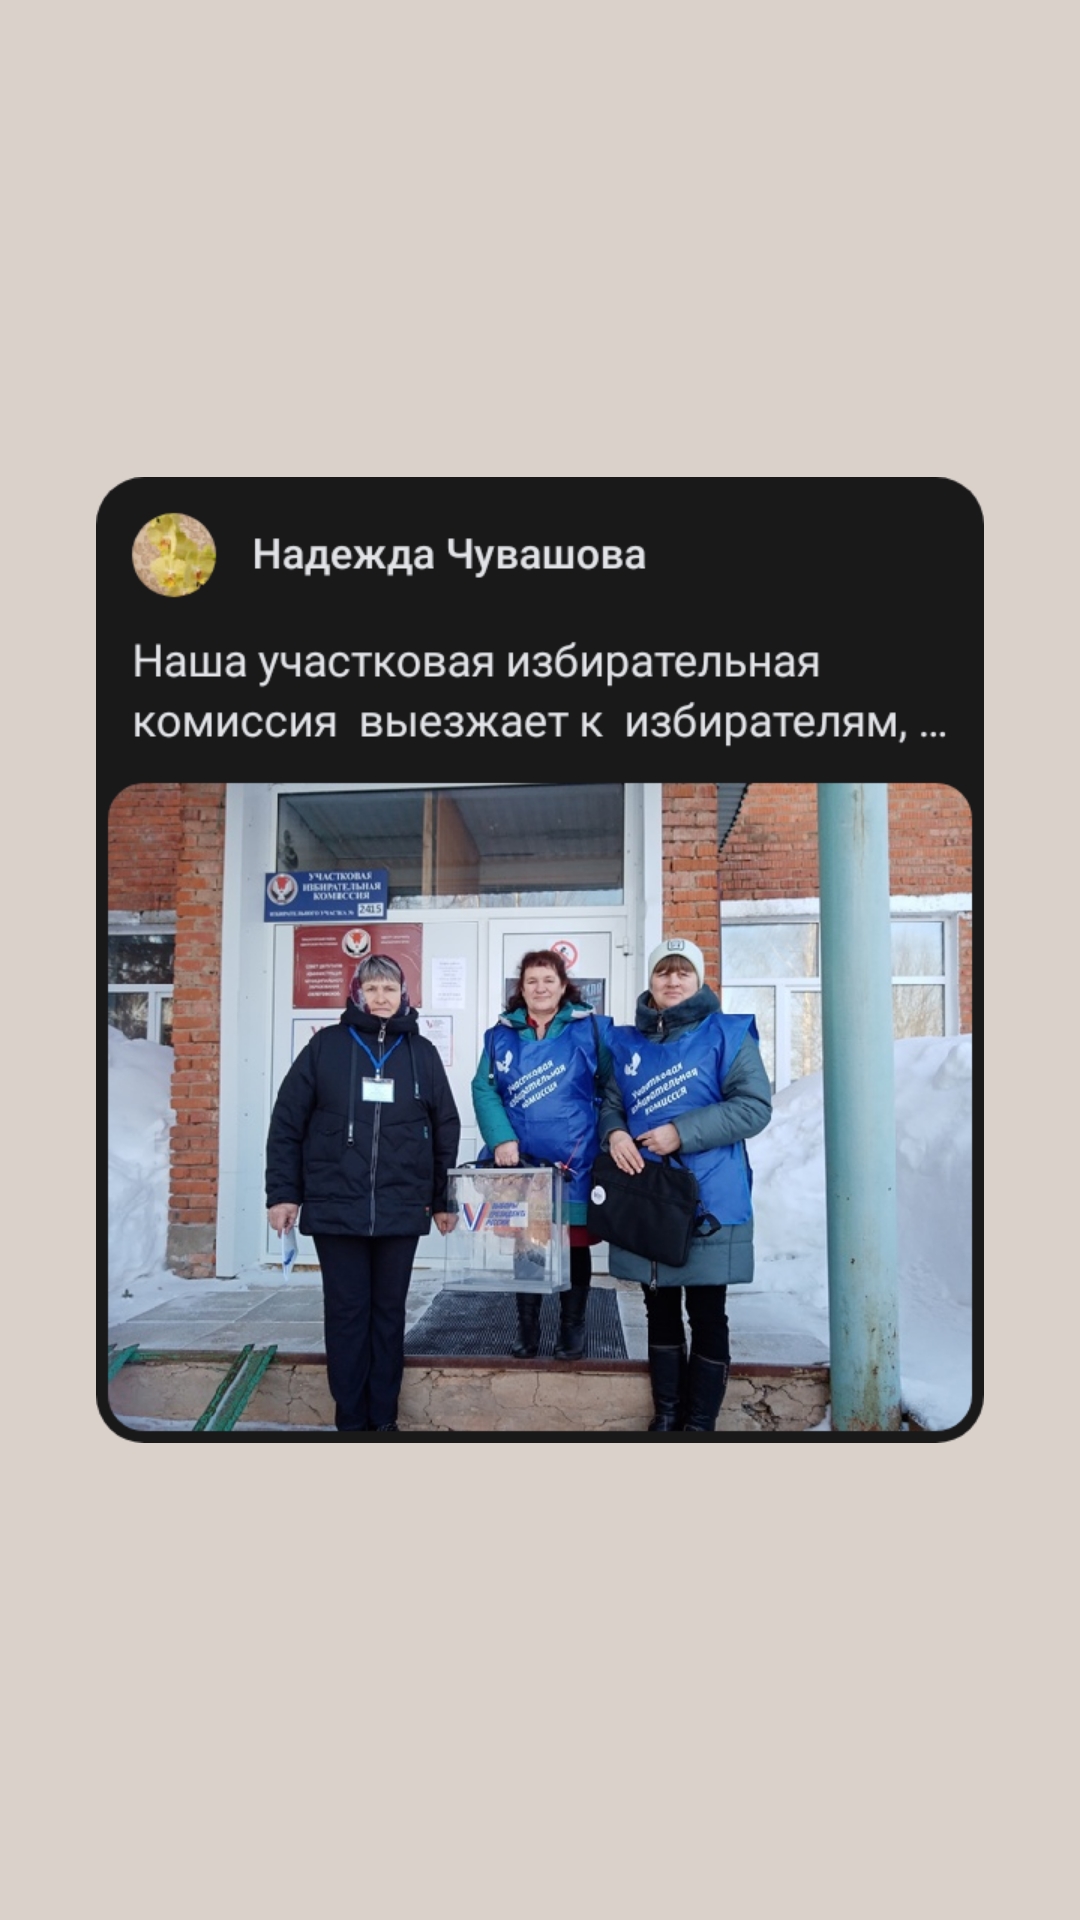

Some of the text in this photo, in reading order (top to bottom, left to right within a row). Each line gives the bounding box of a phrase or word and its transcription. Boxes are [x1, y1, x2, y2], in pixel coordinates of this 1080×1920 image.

[308, 872, 373, 881] УЧАСТКОВАЯ
[302, 882, 382, 892] ИЗБИРАТЕЛЬНАЯ
[313, 891, 370, 900] КОМИССИЯ
[359, 904, 382, 914] 2415
